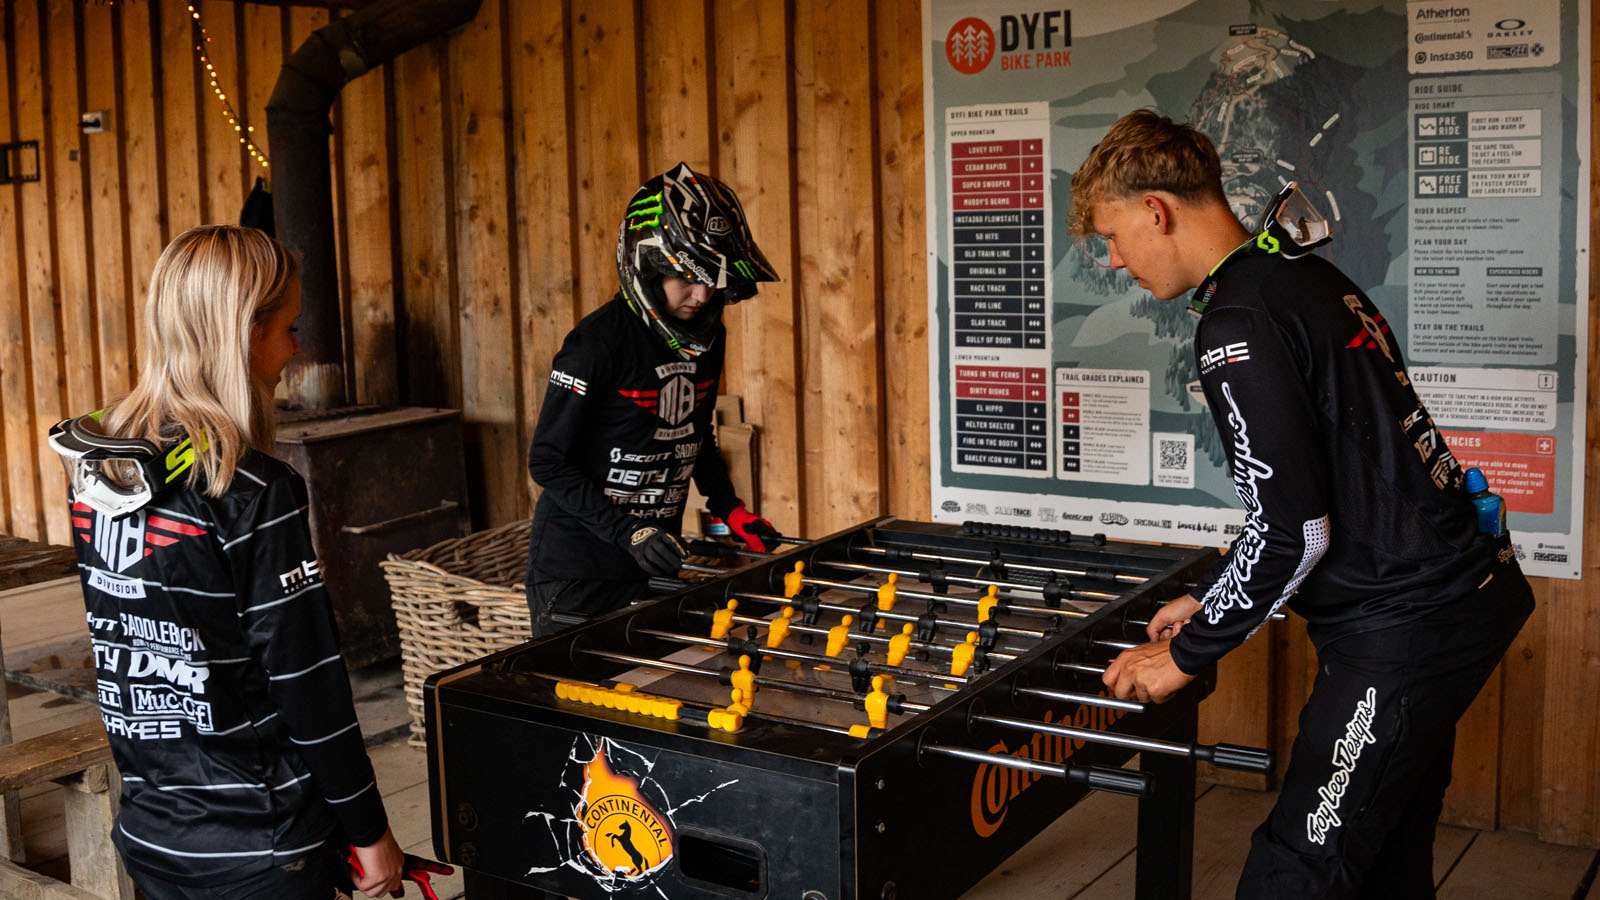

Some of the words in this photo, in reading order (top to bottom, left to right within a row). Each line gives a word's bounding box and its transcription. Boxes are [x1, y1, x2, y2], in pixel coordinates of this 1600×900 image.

[1416, 7, 1470, 20] Atherton
[1000, 9, 1072, 52] DYFI
[1487, 30, 1533, 38] OAKLEY
[1415, 31, 1464, 44] Continental
[1001, 53, 1032, 72] BIKE
[1035, 50, 1072, 69] PARK
[1430, 51, 1473, 62] Insta360
[1414, 85, 1434, 94] RIDE
[1437, 84, 1463, 93] GUIDE
[1433, 101, 1455, 109] SMART
[951, 111, 966, 119] DYFI
[968, 110, 983, 118] BIKE
[985, 109, 1002, 117] PARK
[1004, 107, 1028, 116] TRAILS
[1438, 116, 1456, 126] PRE
[1438, 126, 1461, 136] RIDE
[1438, 155, 1461, 165] RIDE
[965, 163, 984, 171] CEDAR
[1438, 175, 1462, 184] FREE
[962, 181, 981, 189] SUPER
[1438, 184, 1461, 194] RIDE
[984, 215, 1019, 223] FLOWSTATE
[984, 232, 999, 240] HITS
[996, 249, 1010, 257] LINE
[969, 267, 996, 275] ORIGINAL
[970, 284, 985, 292] RACE
[987, 284, 1006, 292] TRACK
[987, 319, 1006, 327] TRACK
[988, 370, 999, 378] THE
[1062, 373, 1080, 381] TRAIL
[1082, 374, 1106, 382] GRADES
[1108, 375, 1144, 383] EXPLAINED
[1413, 373, 1456, 383] CAUTION
[985, 404, 1003, 413] HIPPO
[965, 420, 987, 429] HELTER
[989, 421, 1015, 430] SKELTER
[962, 437, 976, 445] FIRE
[985, 438, 997, 446] THE
[998, 439, 1018, 448] BOOTH
[1445, 436, 1480, 447] ENCIES
[621, 452, 672, 463] SCOTT
[964, 454, 986, 463] OAKLEY
[987, 455, 1002, 464] ICON
[1003, 456, 1017, 465] WAY
[606, 467, 669, 486] DEITY
[627, 505, 679, 519] HAYES
[279, 559, 321, 588] mb
[97, 576, 138, 595] DIVISION
[119, 612, 206, 652] SADDLEBCK
[128, 650, 210, 695] DMR
[586, 799, 670, 848] CONTINENTAL
